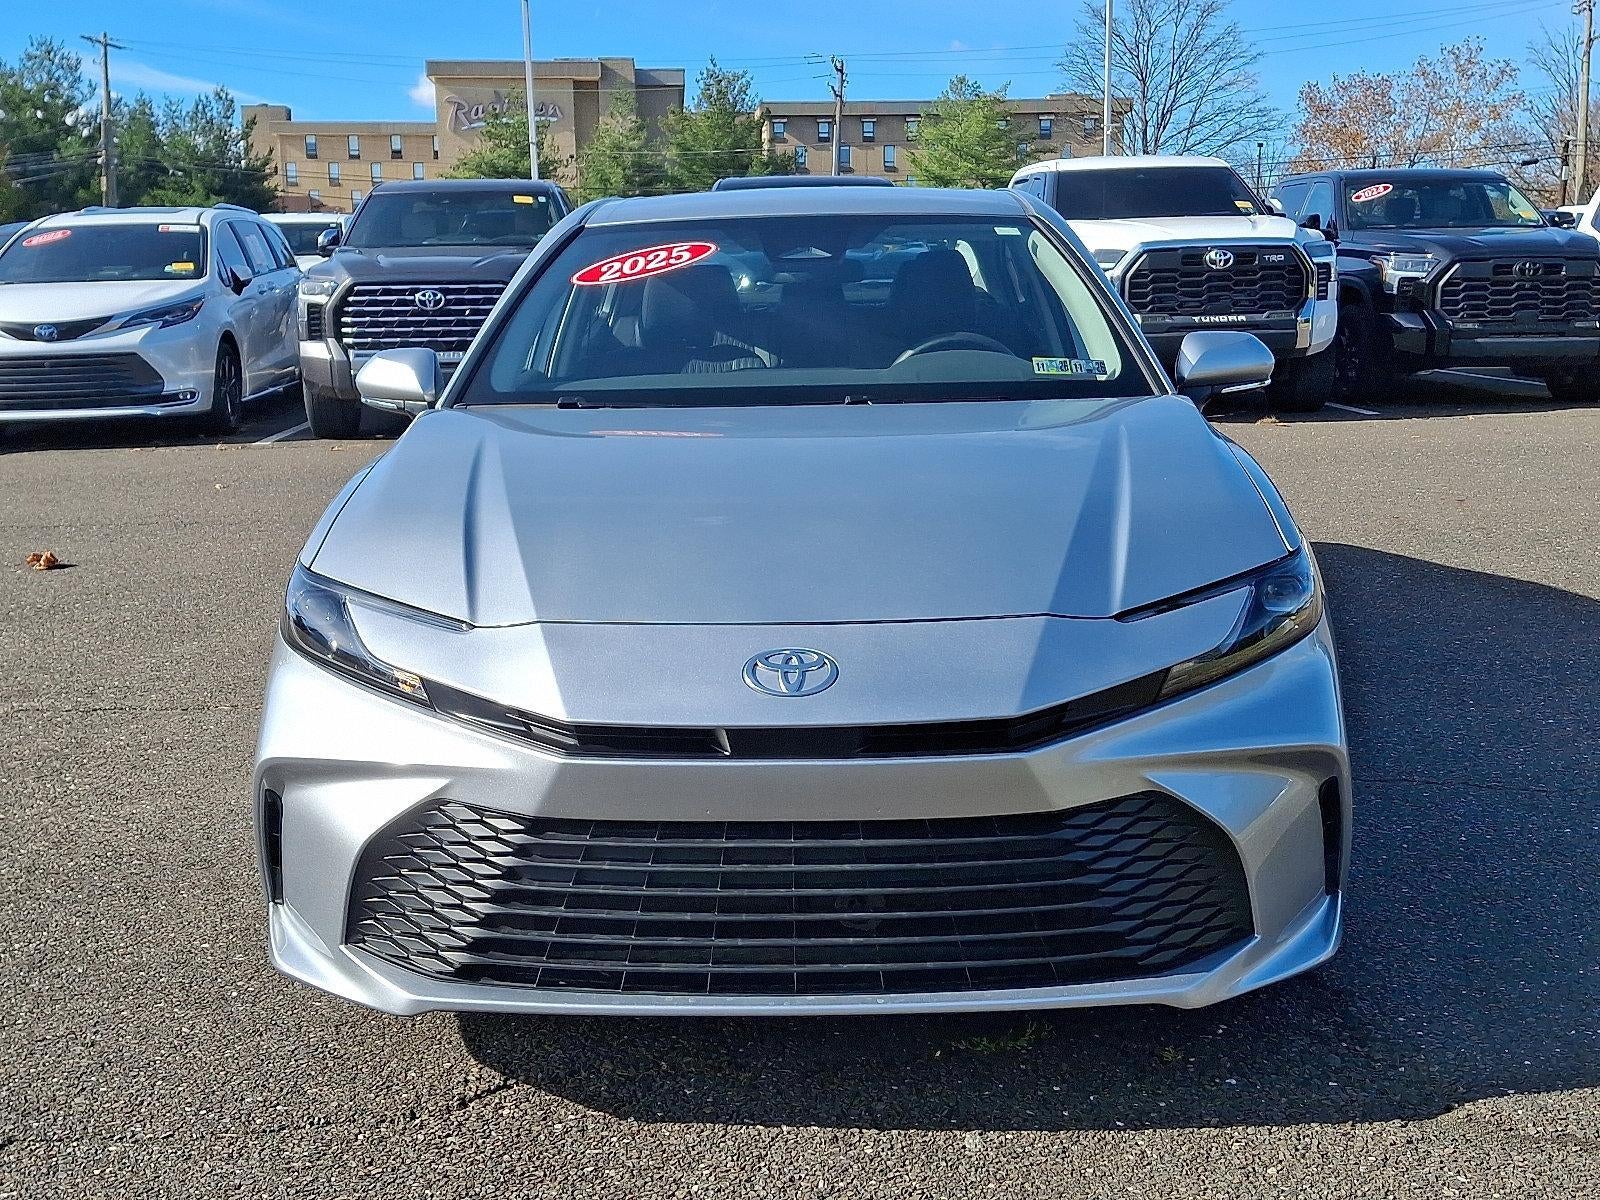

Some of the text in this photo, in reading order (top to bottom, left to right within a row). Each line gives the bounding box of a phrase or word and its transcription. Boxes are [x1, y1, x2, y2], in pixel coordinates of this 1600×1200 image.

[1263, 254, 1285, 262] TRD
[598, 245, 692, 282] 2025
[1192, 315, 1247, 323] TUNDRA
